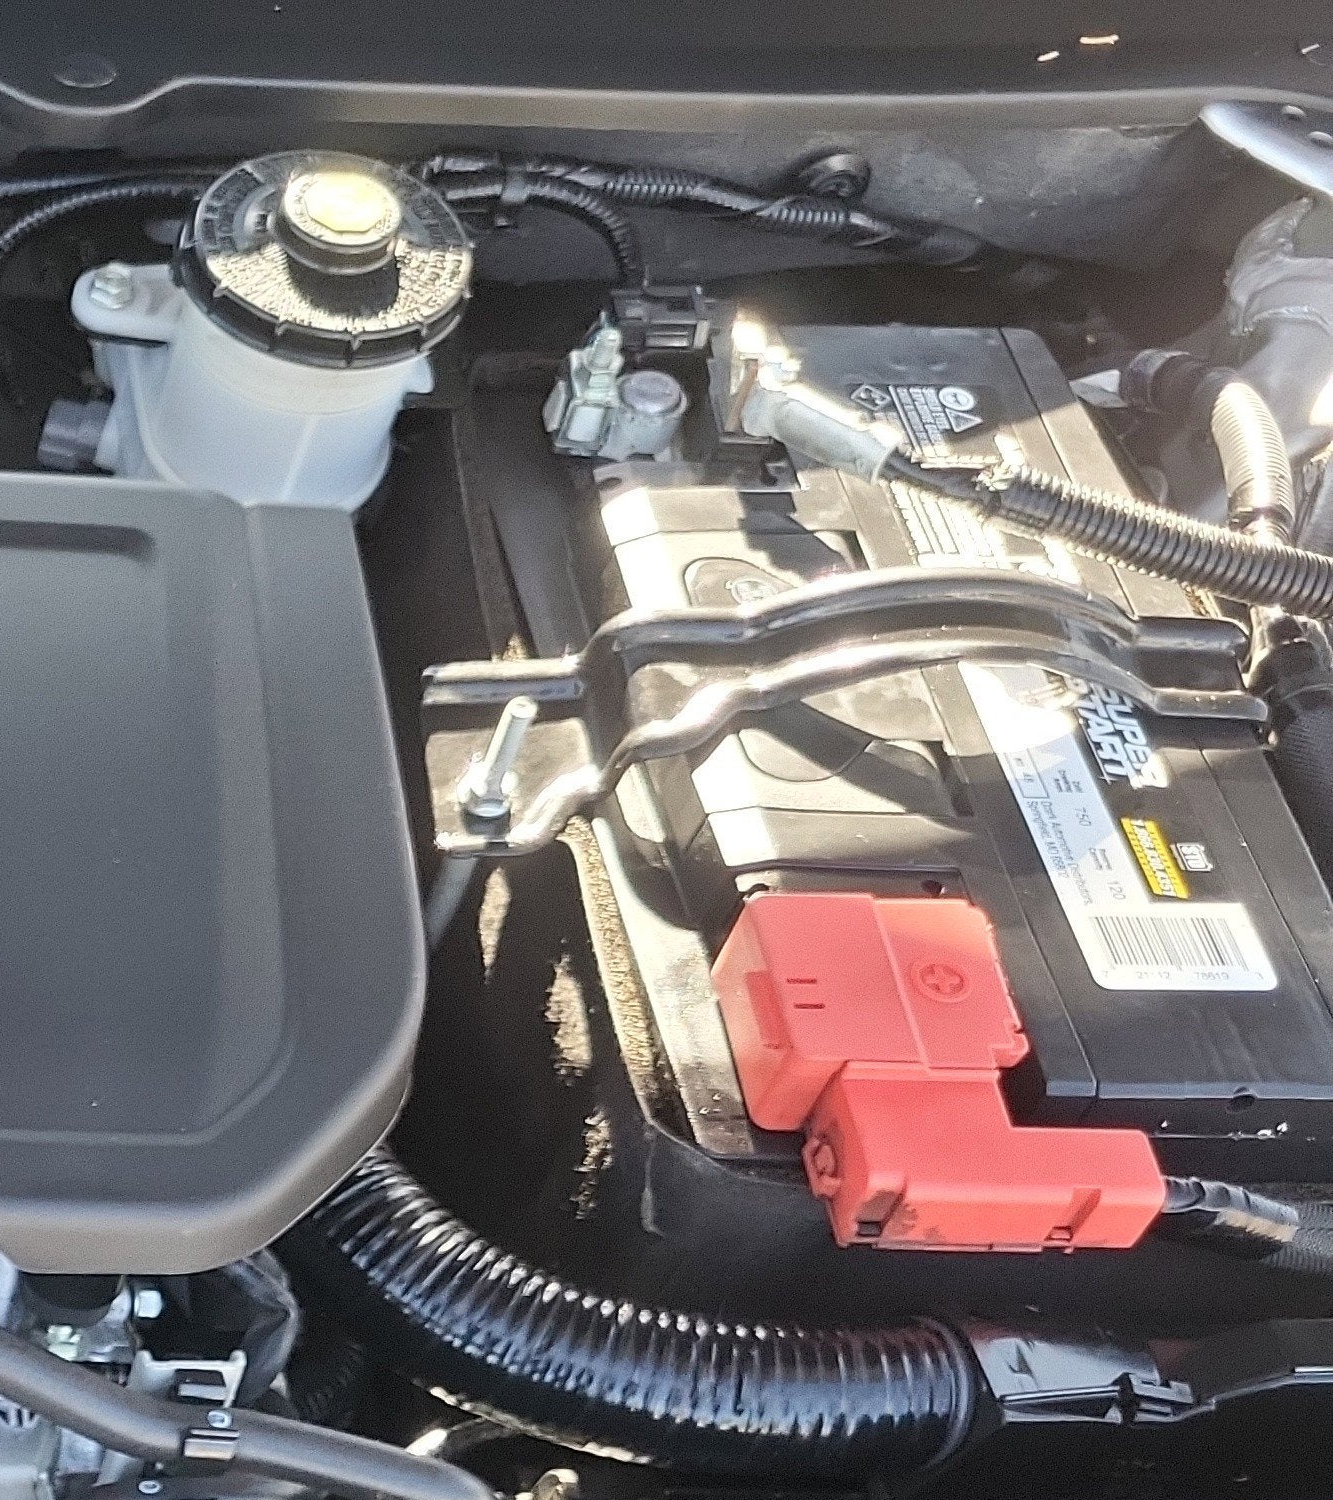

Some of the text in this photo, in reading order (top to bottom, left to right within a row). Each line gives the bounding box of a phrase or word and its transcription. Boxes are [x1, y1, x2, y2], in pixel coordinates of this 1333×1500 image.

[1101, 687, 1168, 789] SUPER
[1075, 807, 1091, 826] 750
[1106, 882, 1126, 900] 120
